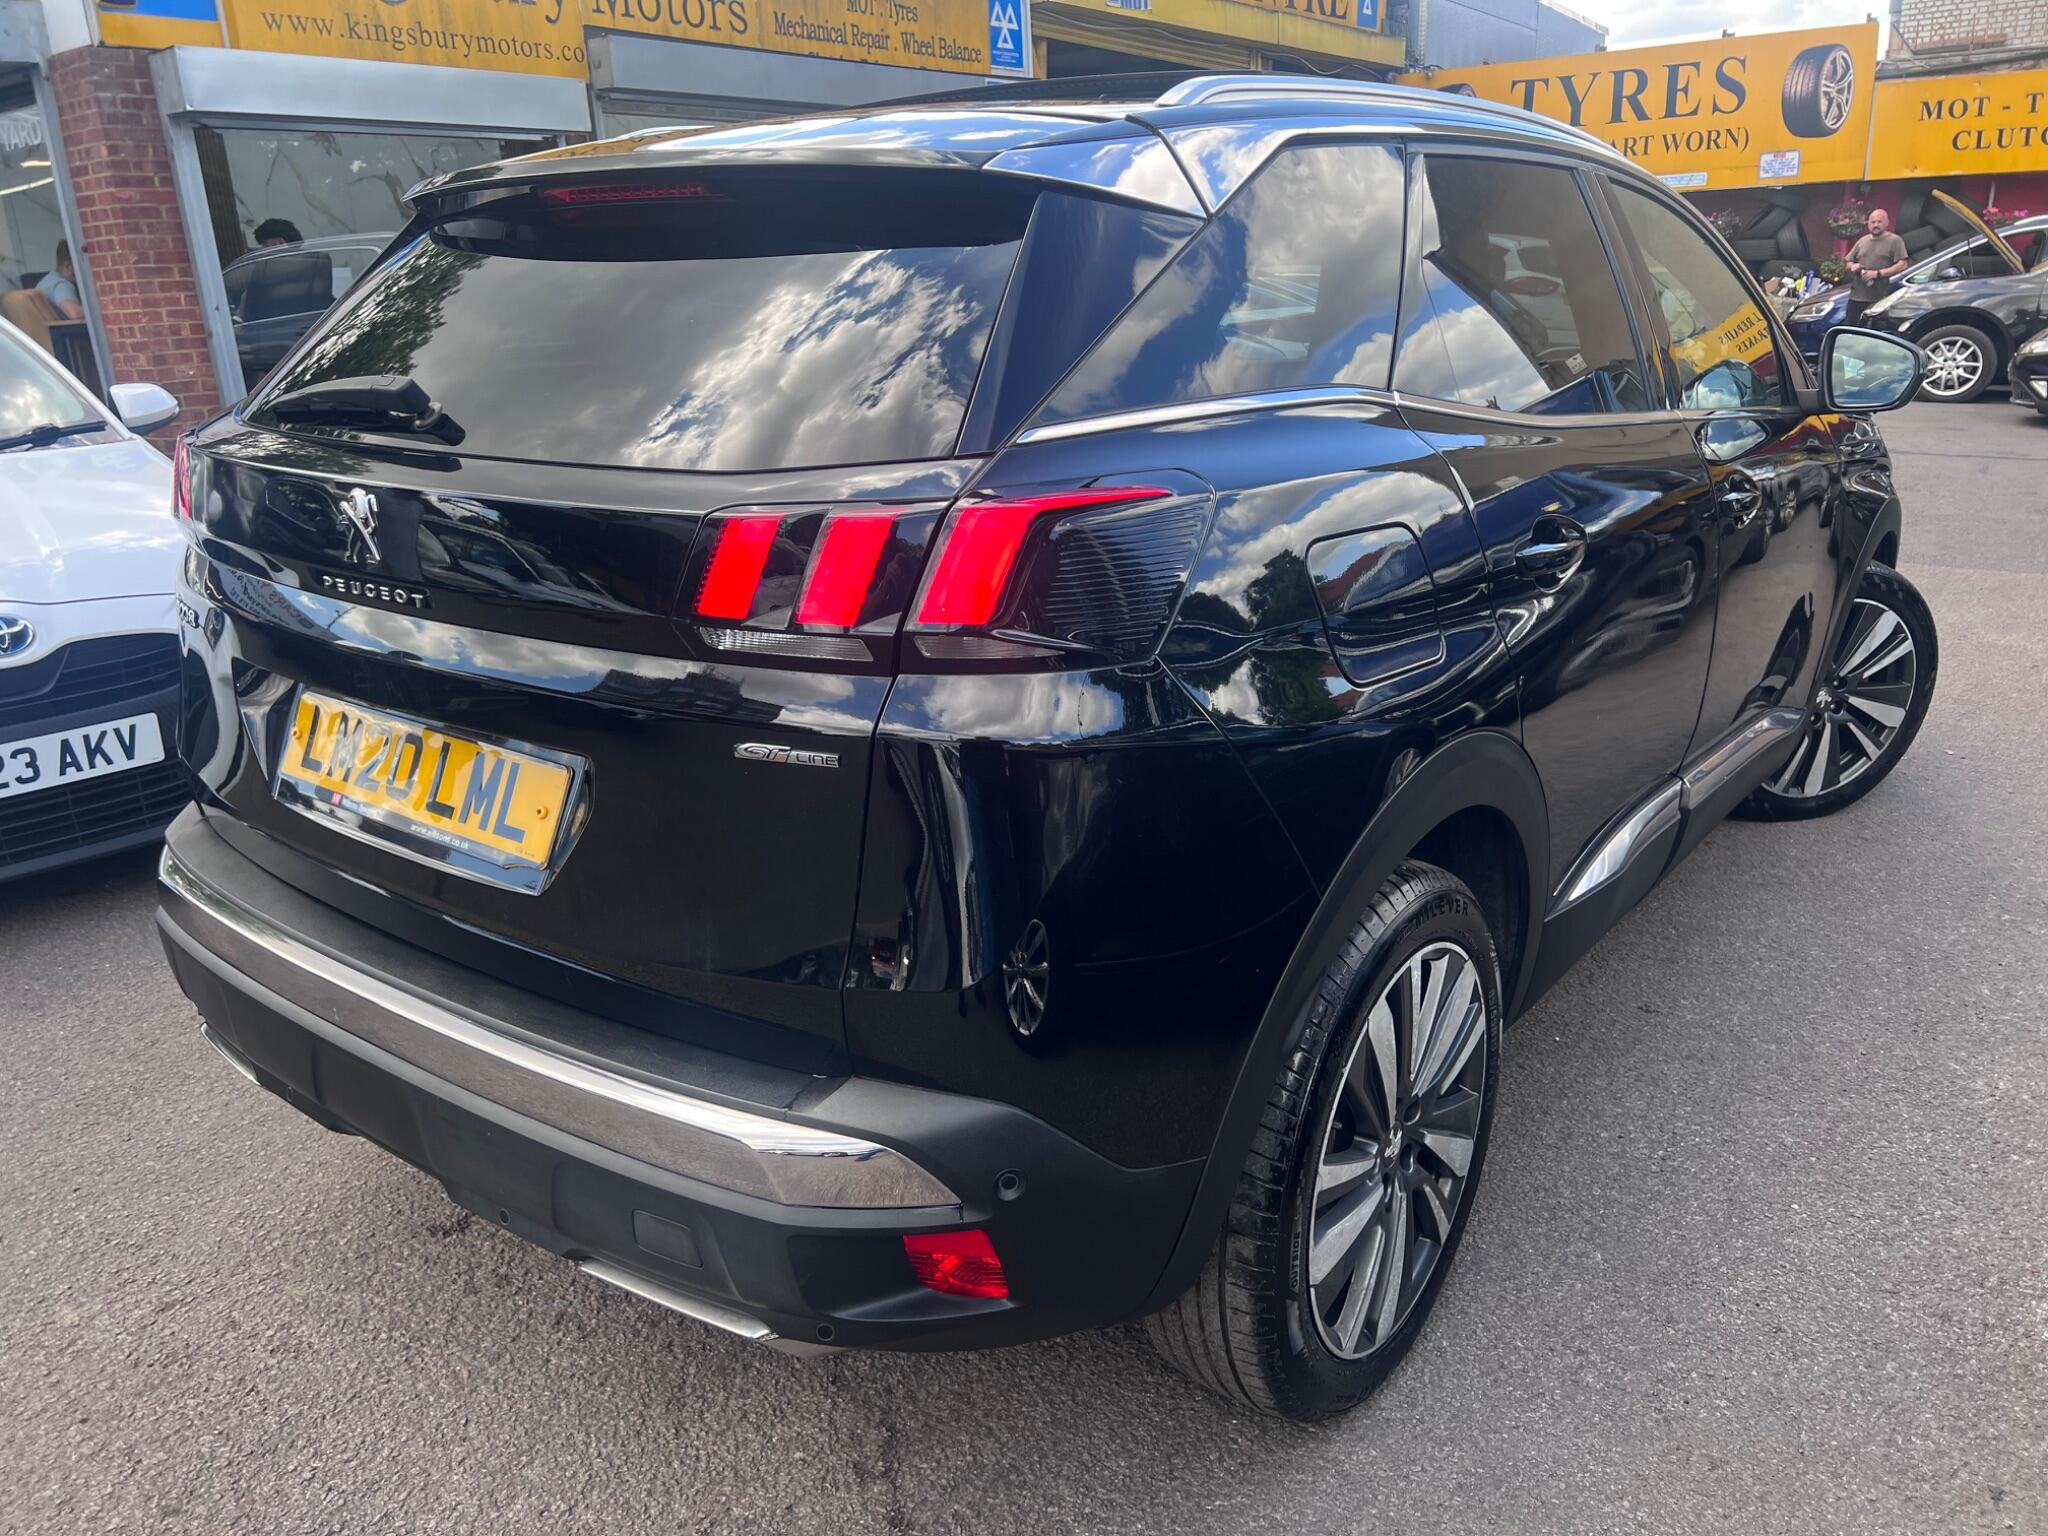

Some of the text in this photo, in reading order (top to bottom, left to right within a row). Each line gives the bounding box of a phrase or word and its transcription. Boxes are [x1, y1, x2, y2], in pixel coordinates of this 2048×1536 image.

[260, 12, 585, 63] www.kingsburymotors.co
[773, 11, 848, 45] Mechanical
[850, 23, 890, 54] Repair
[900, 31, 936, 58] Wheel
[938, 37, 982, 63] Balance
[1510, 55, 1748, 127] TYRES
[1919, 96, 1990, 121] MOT
[1662, 127, 1750, 153] WORN)
[322, 575, 424, 609] PEUGEOT
[59, 724, 136, 777] AKV
[734, 742, 839, 767] GT LINE
[426, 741, 526, 843] LML
